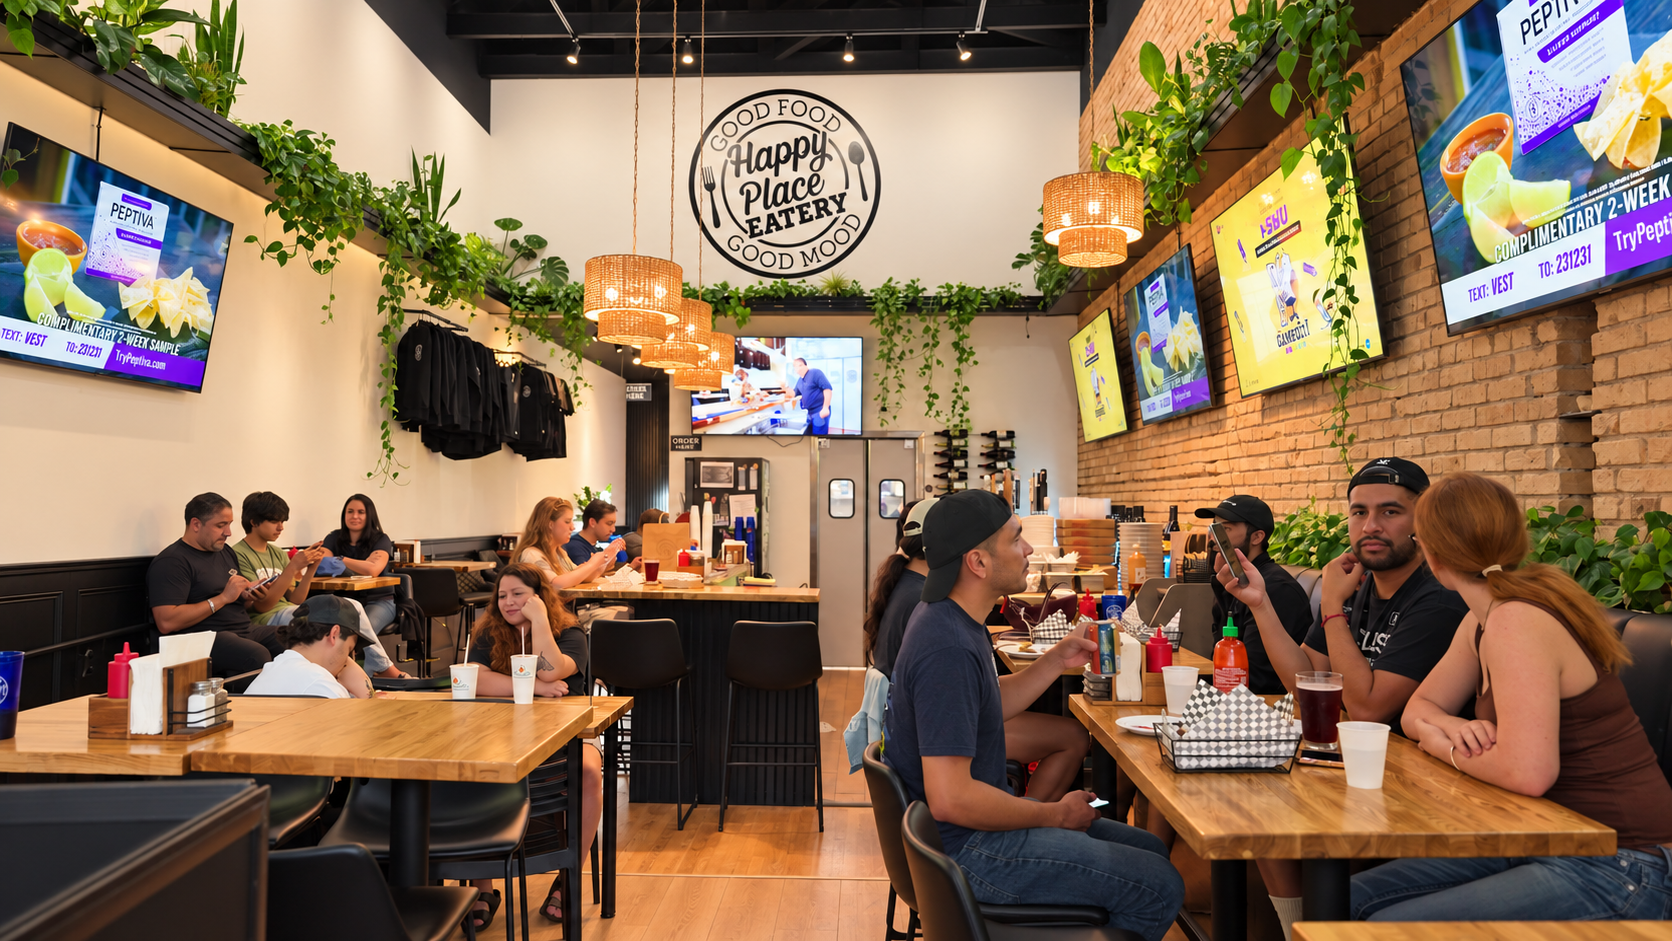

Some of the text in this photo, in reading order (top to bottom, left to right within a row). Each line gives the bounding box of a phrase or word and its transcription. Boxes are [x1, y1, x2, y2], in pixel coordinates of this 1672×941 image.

[710, 98, 842, 152] GOOD FOOD
[726, 130, 834, 178] Happy
[110, 202, 154, 230] PEPTIVA
[738, 172, 826, 216] Place
[745, 191, 848, 240] EATERY
[1494, 200, 1604, 264] COMPLIMENTARY
[1606, 173, 1672, 221] 2-WEEK
[726, 213, 862, 271] GOOD MOOD
[1537, 243, 1592, 279] TO: 231231
[1467, 271, 1515, 303] TEXT: VEST
[1, 327, 49, 348] TEXT: VEST
[36, 312, 118, 342] COMPLIMENTARY
[117, 332, 150, 350] 2-WEEK
[149, 338, 181, 357] SAMPLE
[66, 341, 78, 354] TO:
[672, 437, 700, 445] ORDER
